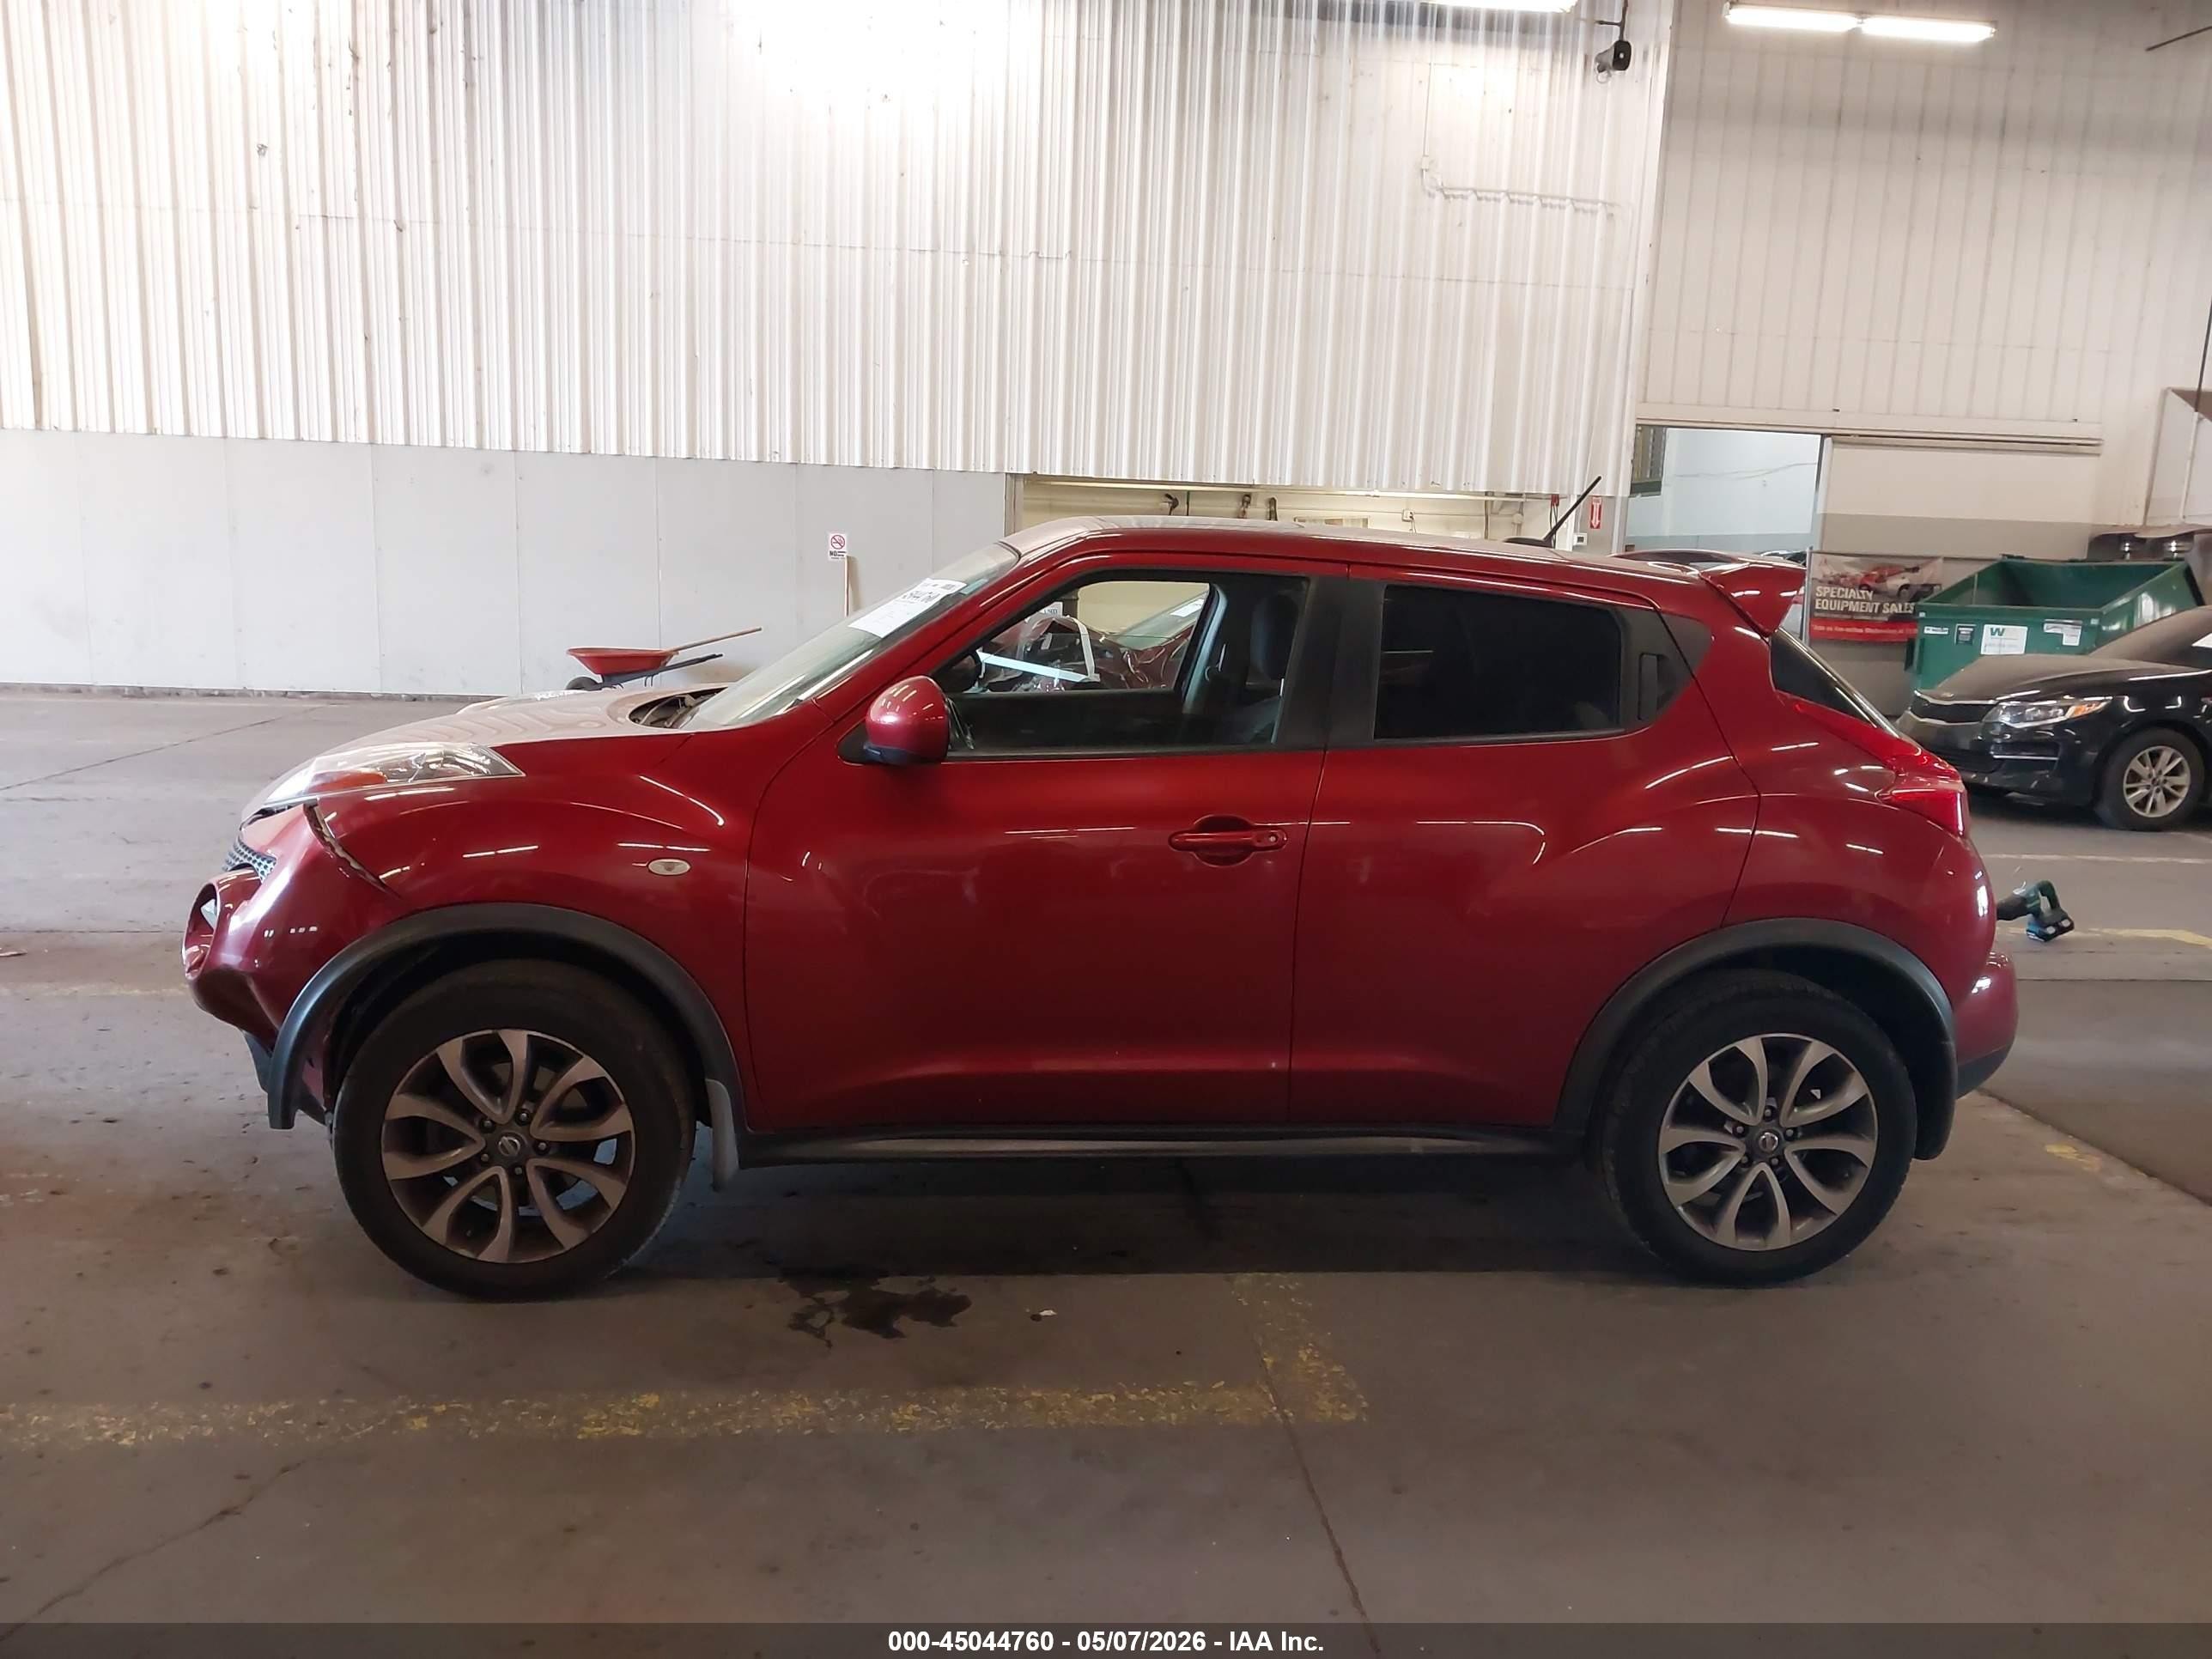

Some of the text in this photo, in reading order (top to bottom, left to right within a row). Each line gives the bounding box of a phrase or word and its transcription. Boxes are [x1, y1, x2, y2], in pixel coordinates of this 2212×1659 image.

[1815, 586, 1874, 600] SPECIALTY
[1814, 599, 1915, 615] EQUIPMENT SALES
